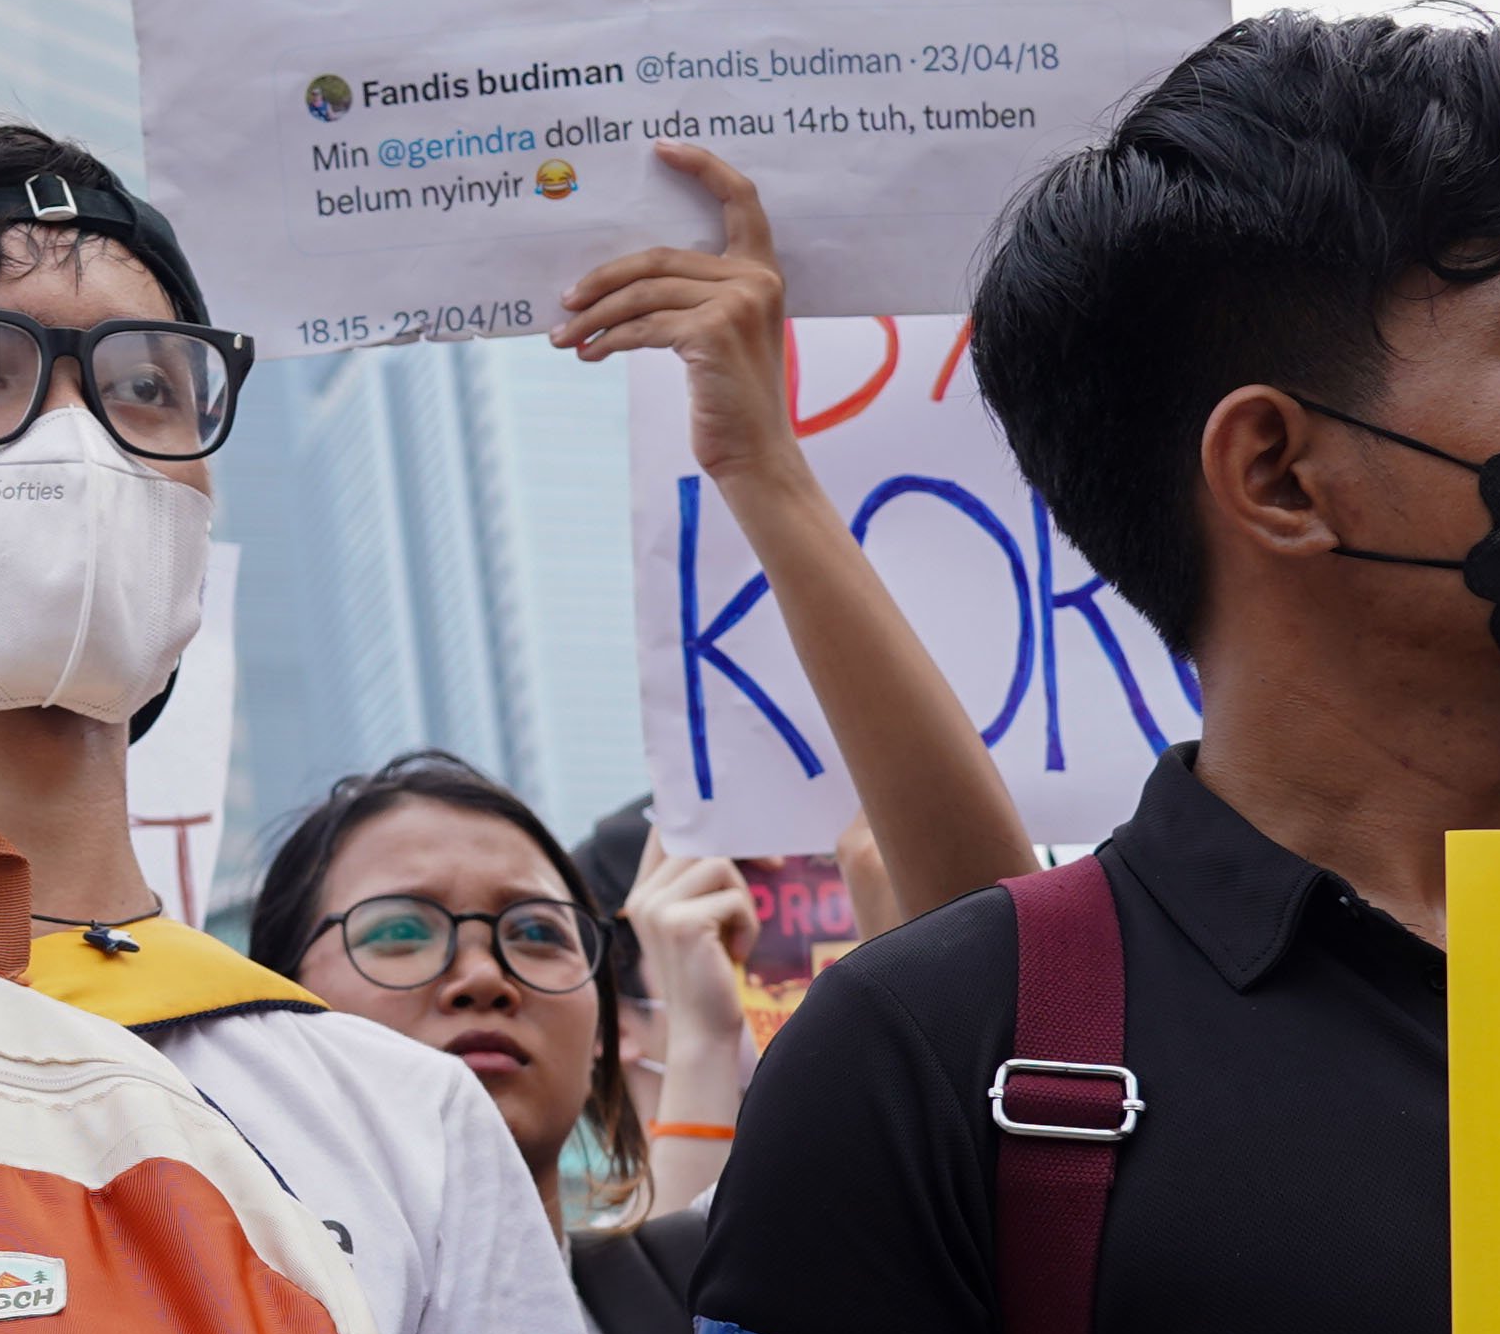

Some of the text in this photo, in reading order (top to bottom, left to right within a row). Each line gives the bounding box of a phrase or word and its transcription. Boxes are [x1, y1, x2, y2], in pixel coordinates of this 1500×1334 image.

[363, 42, 1059, 109] Fandis budiman @fandis_budiman 23/04/18
[313, 101, 1037, 173] Min @gerindra dollar uda mau 14rb tuh, tumben
[316, 172, 523, 217] belum nyinyir
[297, 315, 369, 345] 18.15
[678, 474, 1202, 799] KOR
